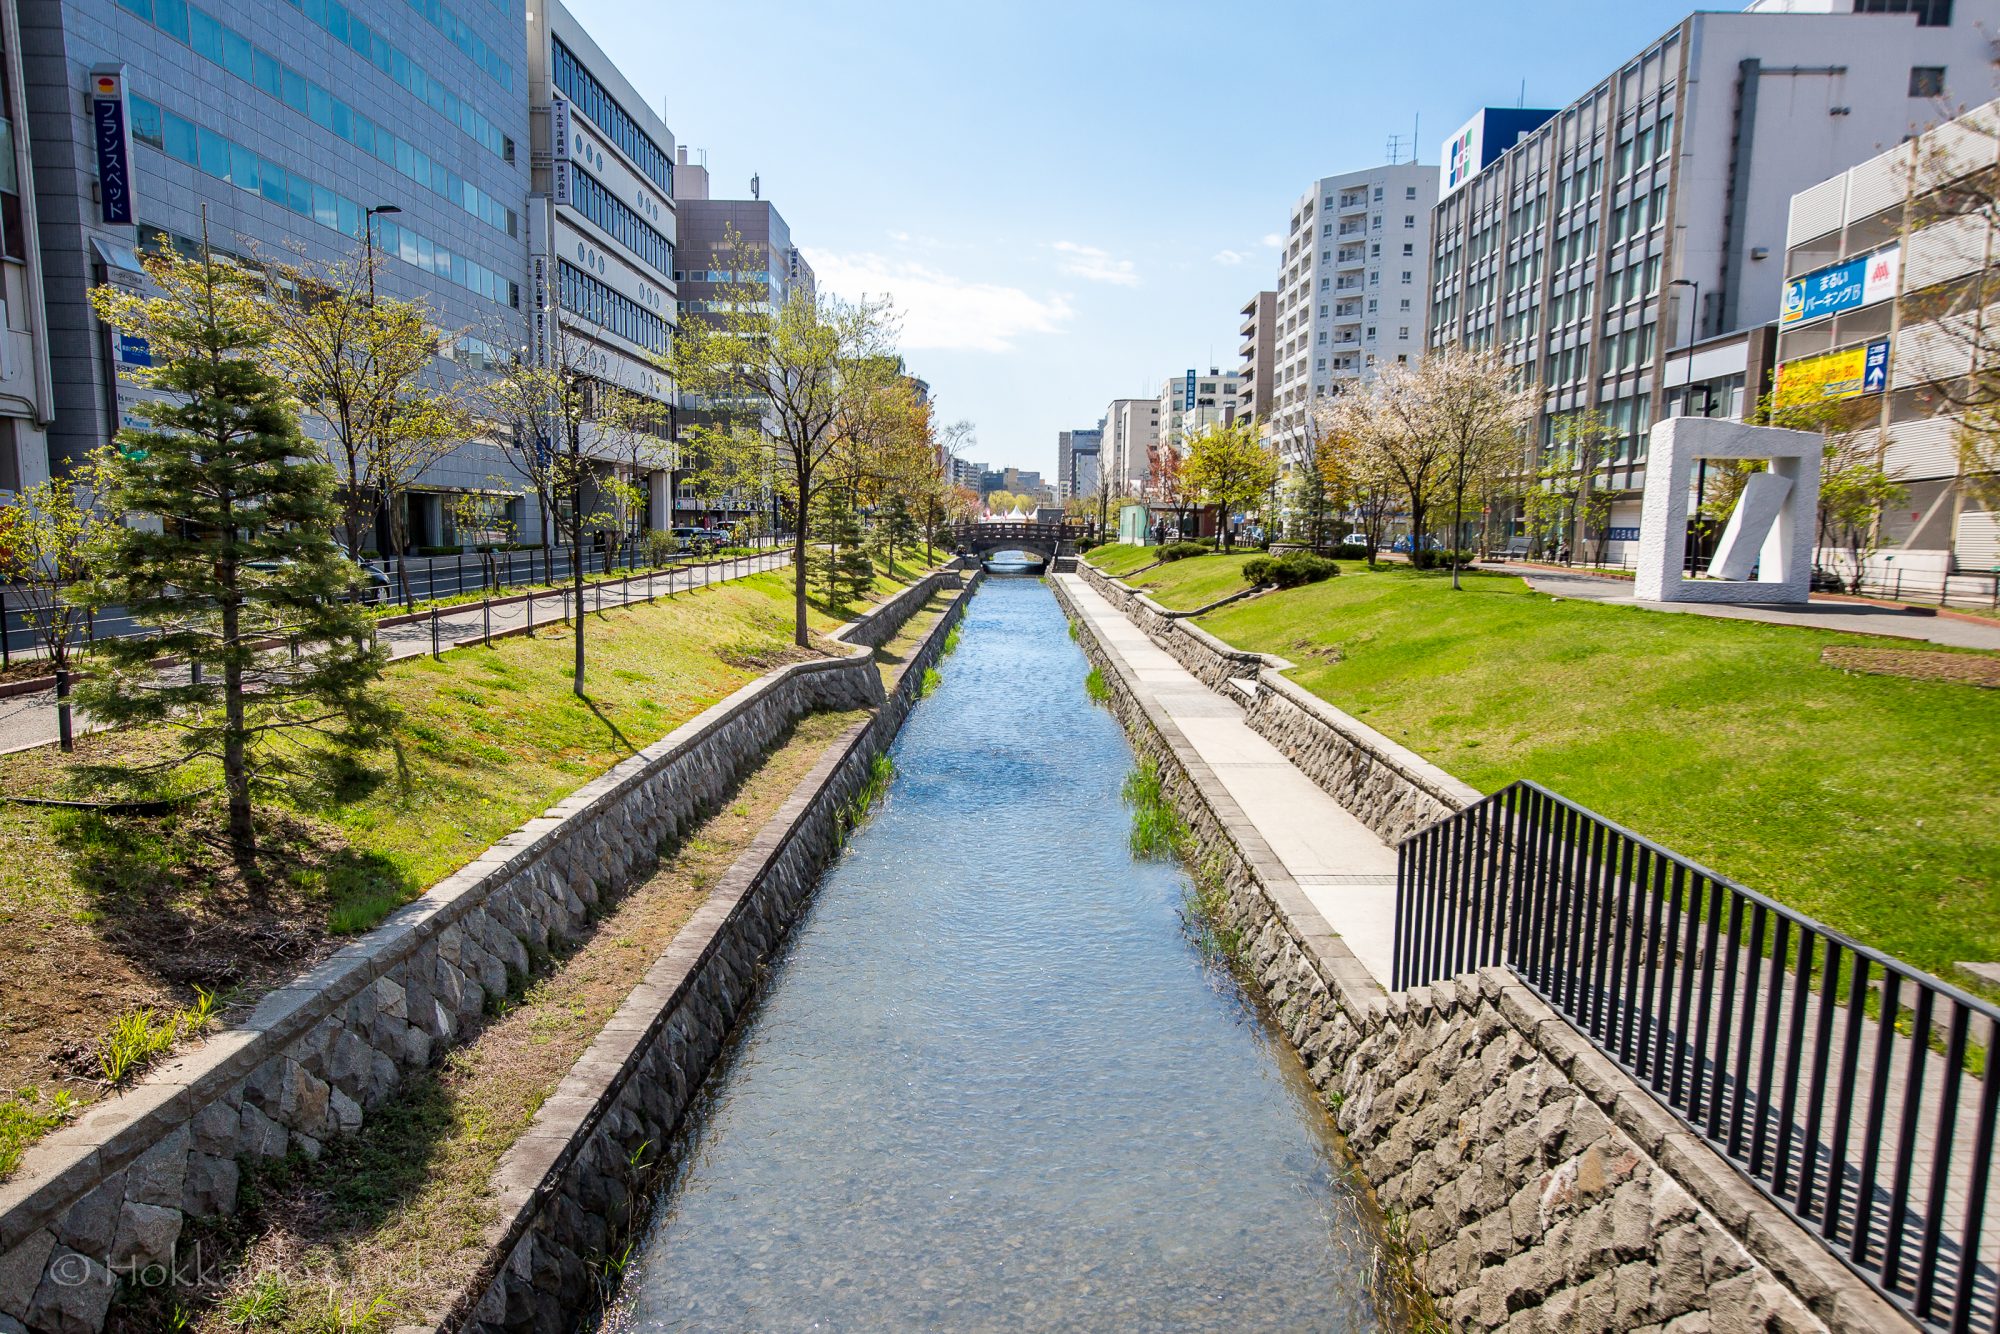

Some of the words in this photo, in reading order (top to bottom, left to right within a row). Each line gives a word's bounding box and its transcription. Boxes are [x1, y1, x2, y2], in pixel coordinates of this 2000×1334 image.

[101, 102, 122, 218] フランスベッド
[557, 165, 565, 198] 株式会社
[1820, 271, 1849, 292] まるい
